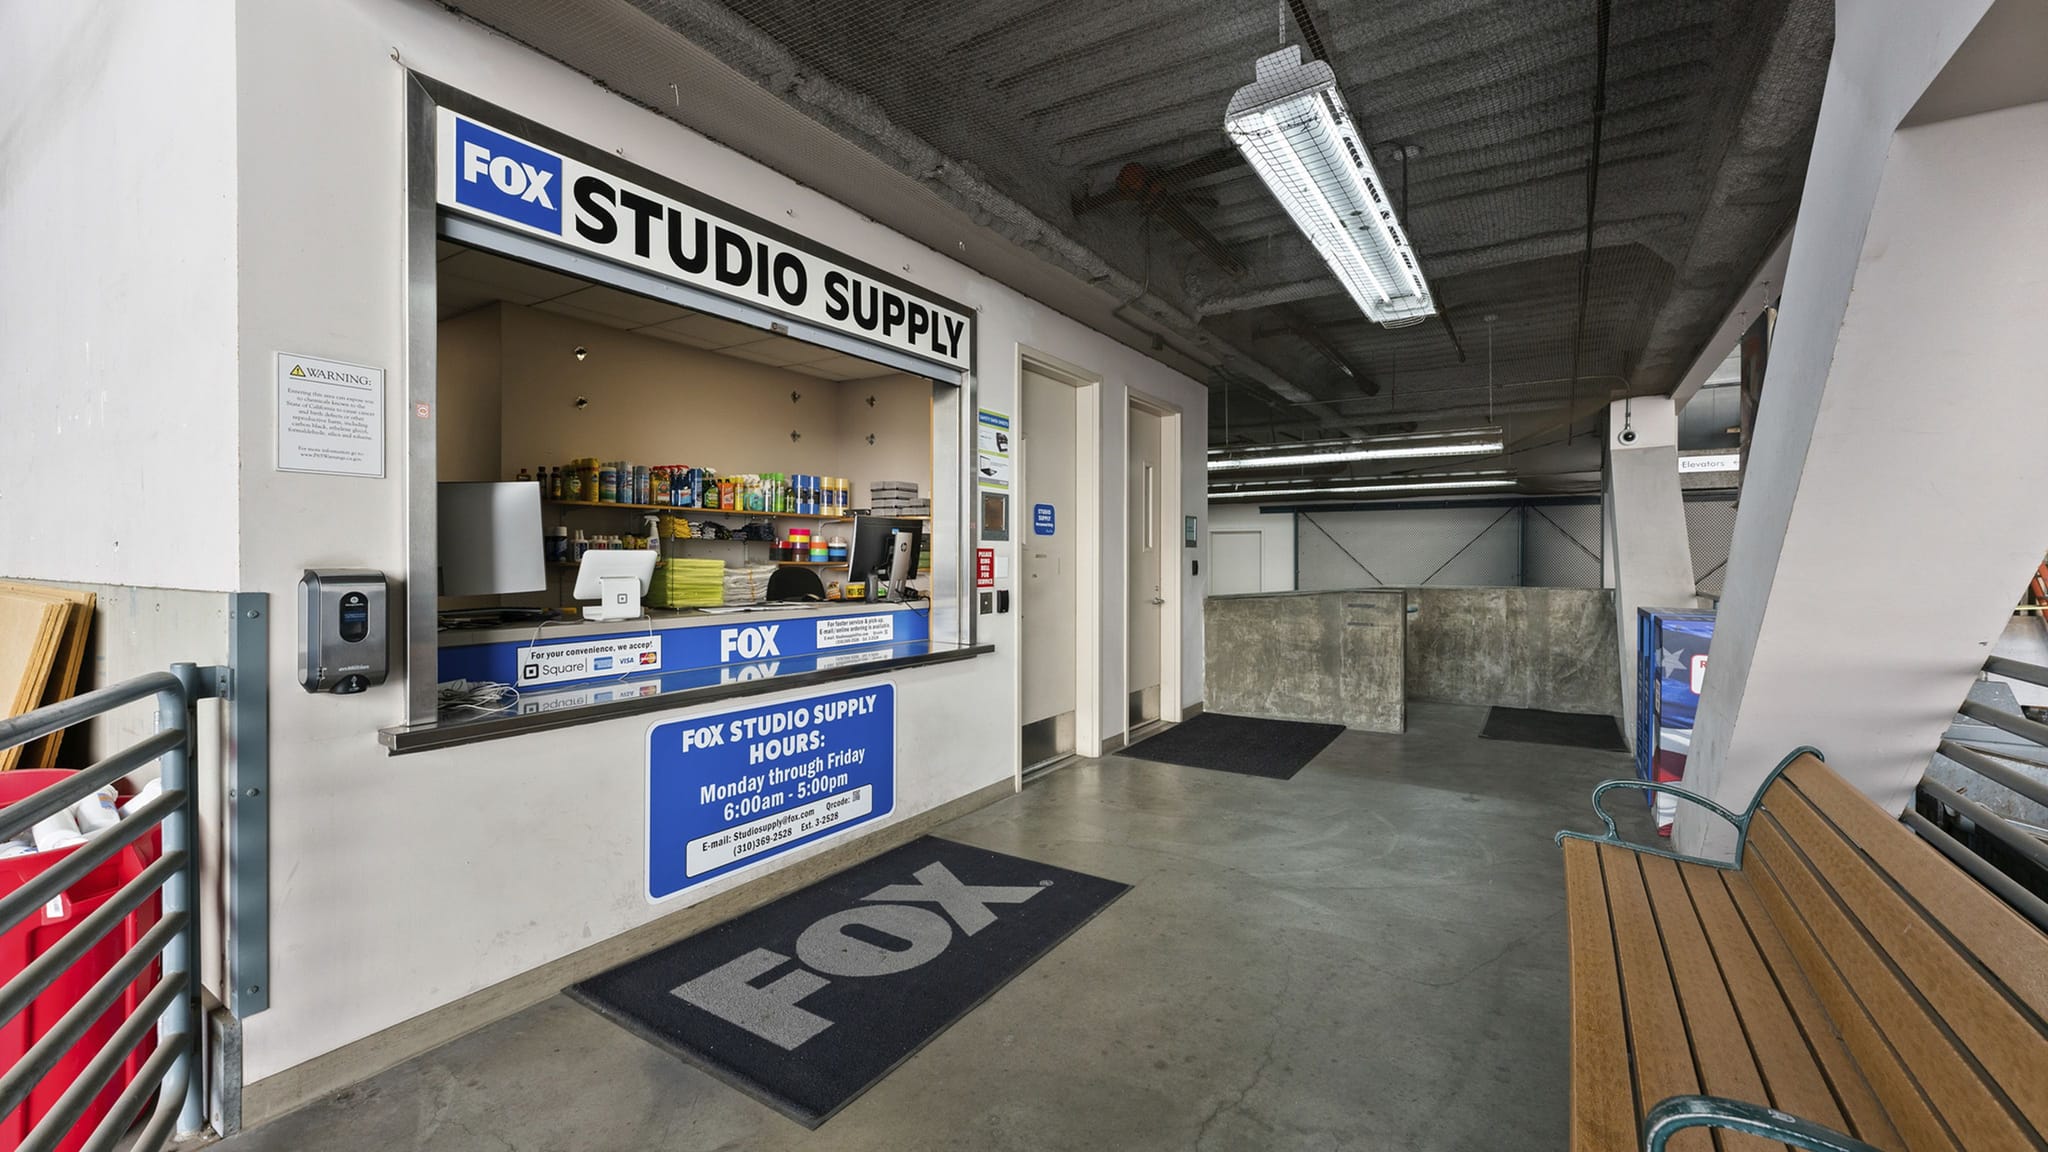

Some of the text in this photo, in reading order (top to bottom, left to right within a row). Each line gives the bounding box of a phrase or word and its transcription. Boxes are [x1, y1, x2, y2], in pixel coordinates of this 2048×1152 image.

[464, 140, 556, 211] FOX
[573, 176, 964, 359] STUDIO SUPPLY
[307, 367, 372, 386] WARNING:
[531, 651, 545, 660] For
[546, 648, 564, 660] your
[566, 646, 616, 656] convenience,
[721, 625, 780, 662] FOX
[543, 662, 585, 676] Square
[682, 694, 877, 752] FOX STUDIO SUPPLY
[750, 730, 825, 765] HOURS:
[700, 748, 865, 804] Monday through Friday
[724, 792, 784, 821] 6:00am
[797, 773, 848, 800] 5:00pm
[702, 796, 850, 851] E-mail: Studiosupply@fox.com Qrcode:
[733, 811, 839, 857] (310)369-2528 Ext. 3-2528
[669, 861, 1048, 1051] FOX
